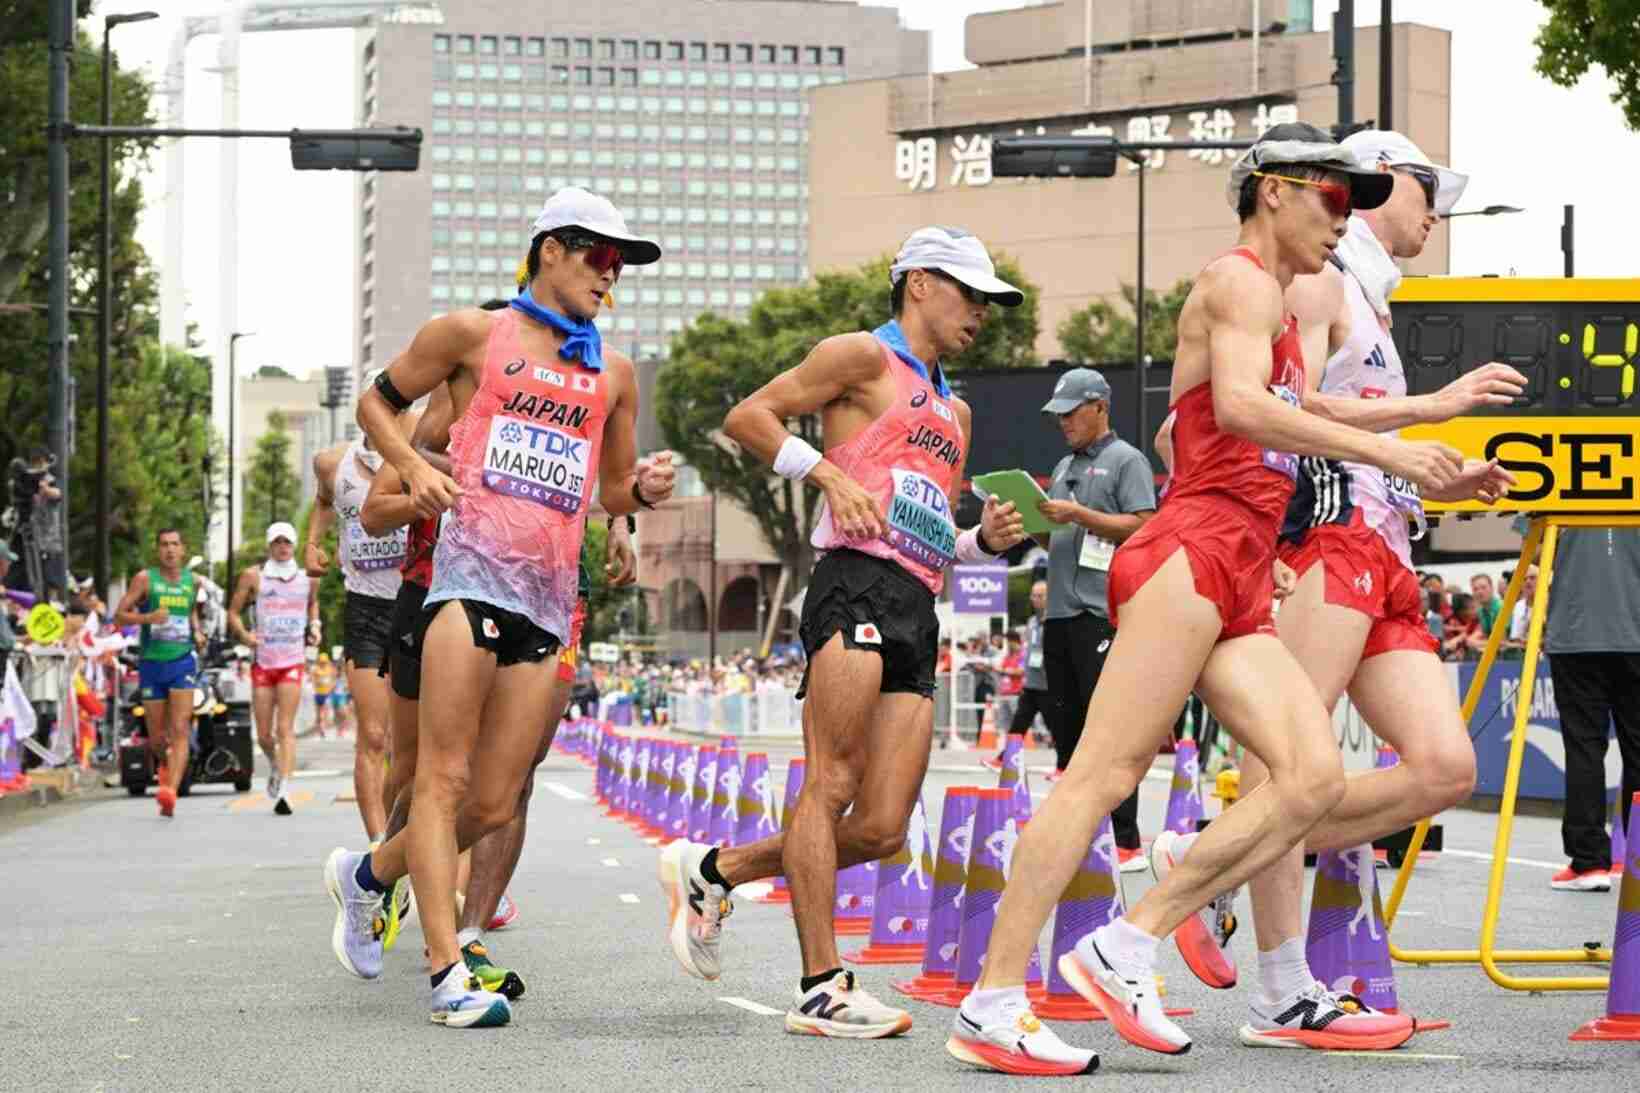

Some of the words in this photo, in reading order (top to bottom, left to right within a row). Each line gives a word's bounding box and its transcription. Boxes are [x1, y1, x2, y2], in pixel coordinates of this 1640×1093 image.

[503, 391, 588, 428] JAPAN
[524, 425, 583, 463] TDK
[907, 425, 960, 466] JAPAN
[489, 447, 568, 487] MARUO
[351, 540, 400, 558] HURTADO
